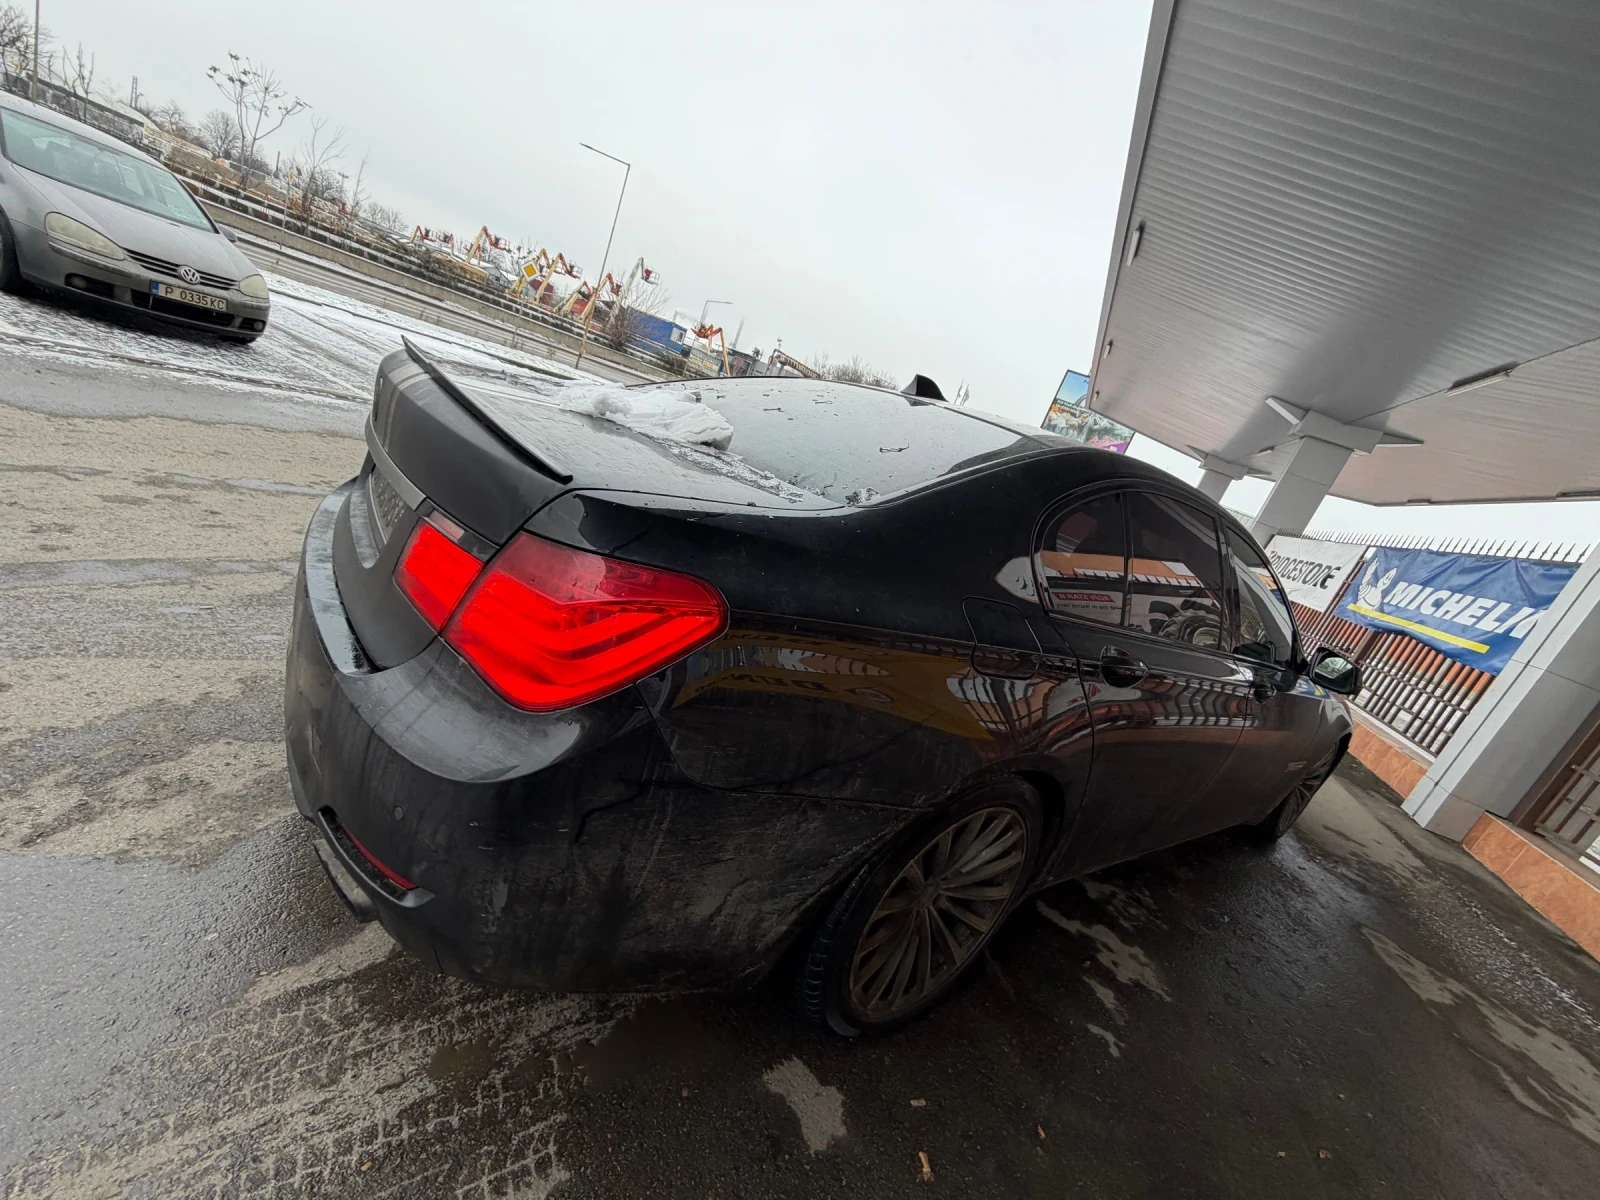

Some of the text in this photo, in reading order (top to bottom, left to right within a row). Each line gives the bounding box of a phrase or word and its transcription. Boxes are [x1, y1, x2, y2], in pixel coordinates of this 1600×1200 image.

[165, 286, 173, 296] P
[180, 290, 208, 306] 0335
[210, 298, 224, 310] KC
